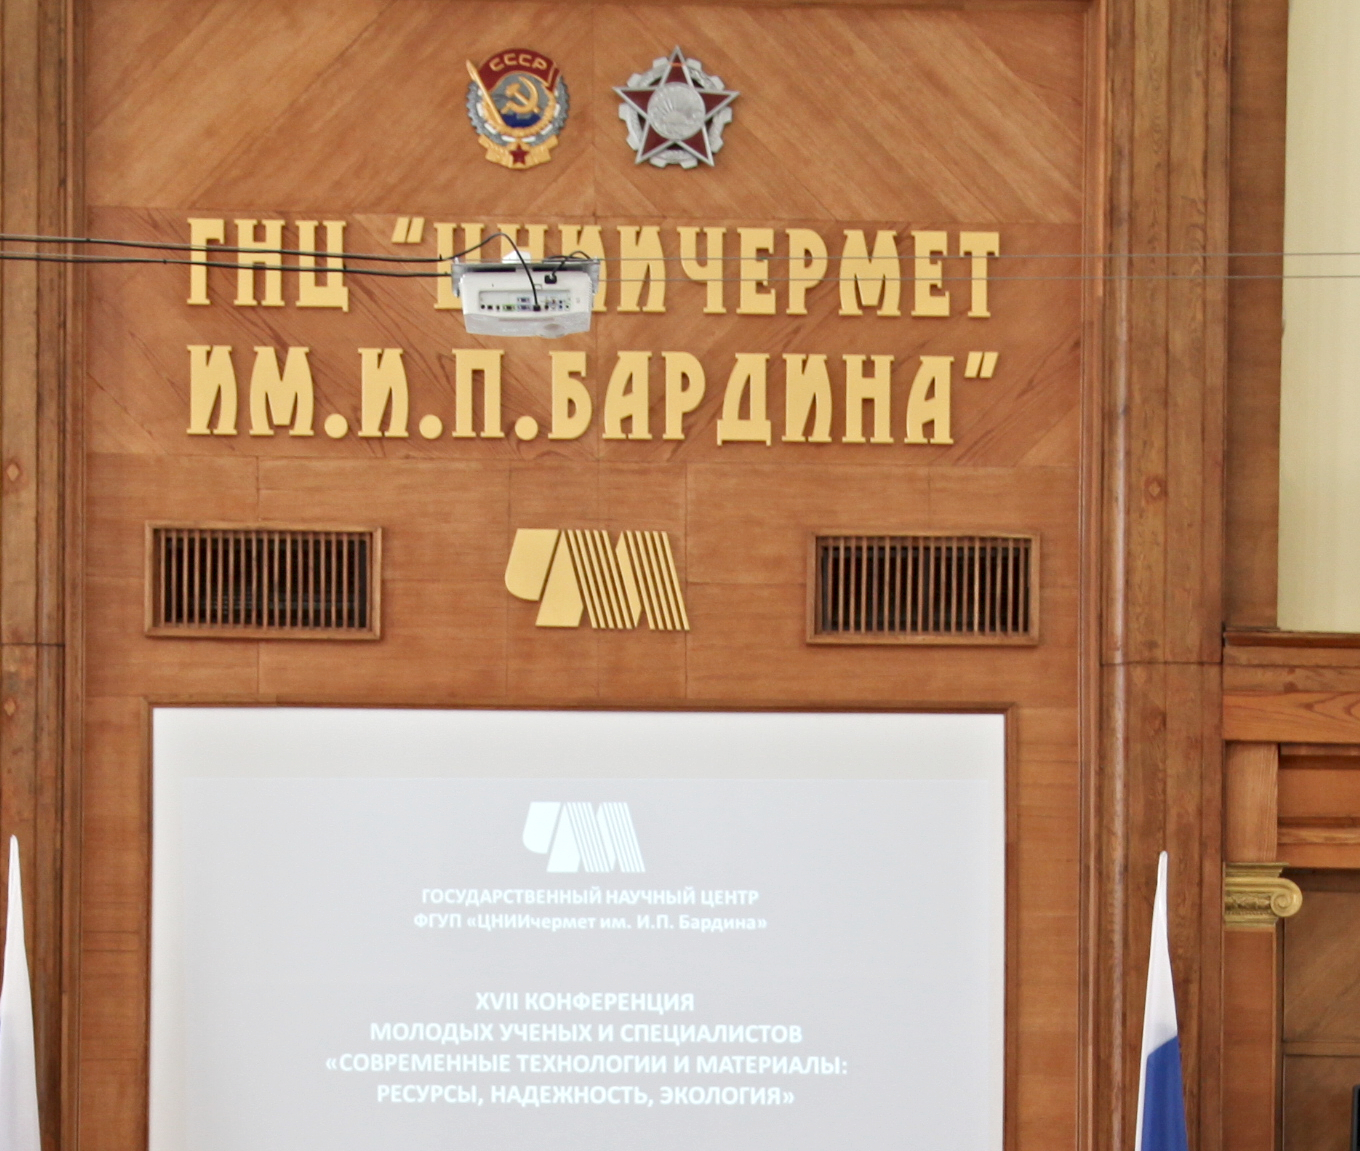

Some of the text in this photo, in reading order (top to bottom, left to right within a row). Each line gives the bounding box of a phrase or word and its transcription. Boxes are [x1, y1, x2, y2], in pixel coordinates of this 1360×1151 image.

[489, 52, 548, 72] СССР
[186, 217, 350, 312] ГНЦ
[422, 886, 759, 908] ГОСУДАРСТВЕННЫЙ НАУЧНЫЙ ЦЕНТР
[413, 913, 767, 933] ФГУП «ЦНИИчермет им. И.П. Бардина»
[475, 991, 694, 1016] XVII КОНФЕРЕНЦИЯ
[370, 1022, 803, 1047] МОЛОДЫХ УЧЕНЫХ И СПЕЦИАЛИСТОВ
[325, 1053, 848, 1075] «СОВРЕМЕННЫЕ ТЕХНОЛОГИИ И МАТЕРИАЛЫ:
[377, 1084, 795, 1108] РЕСУРСЫ, НАДЕЖНОСТЬ, ЭКОЛОГИЯ»
